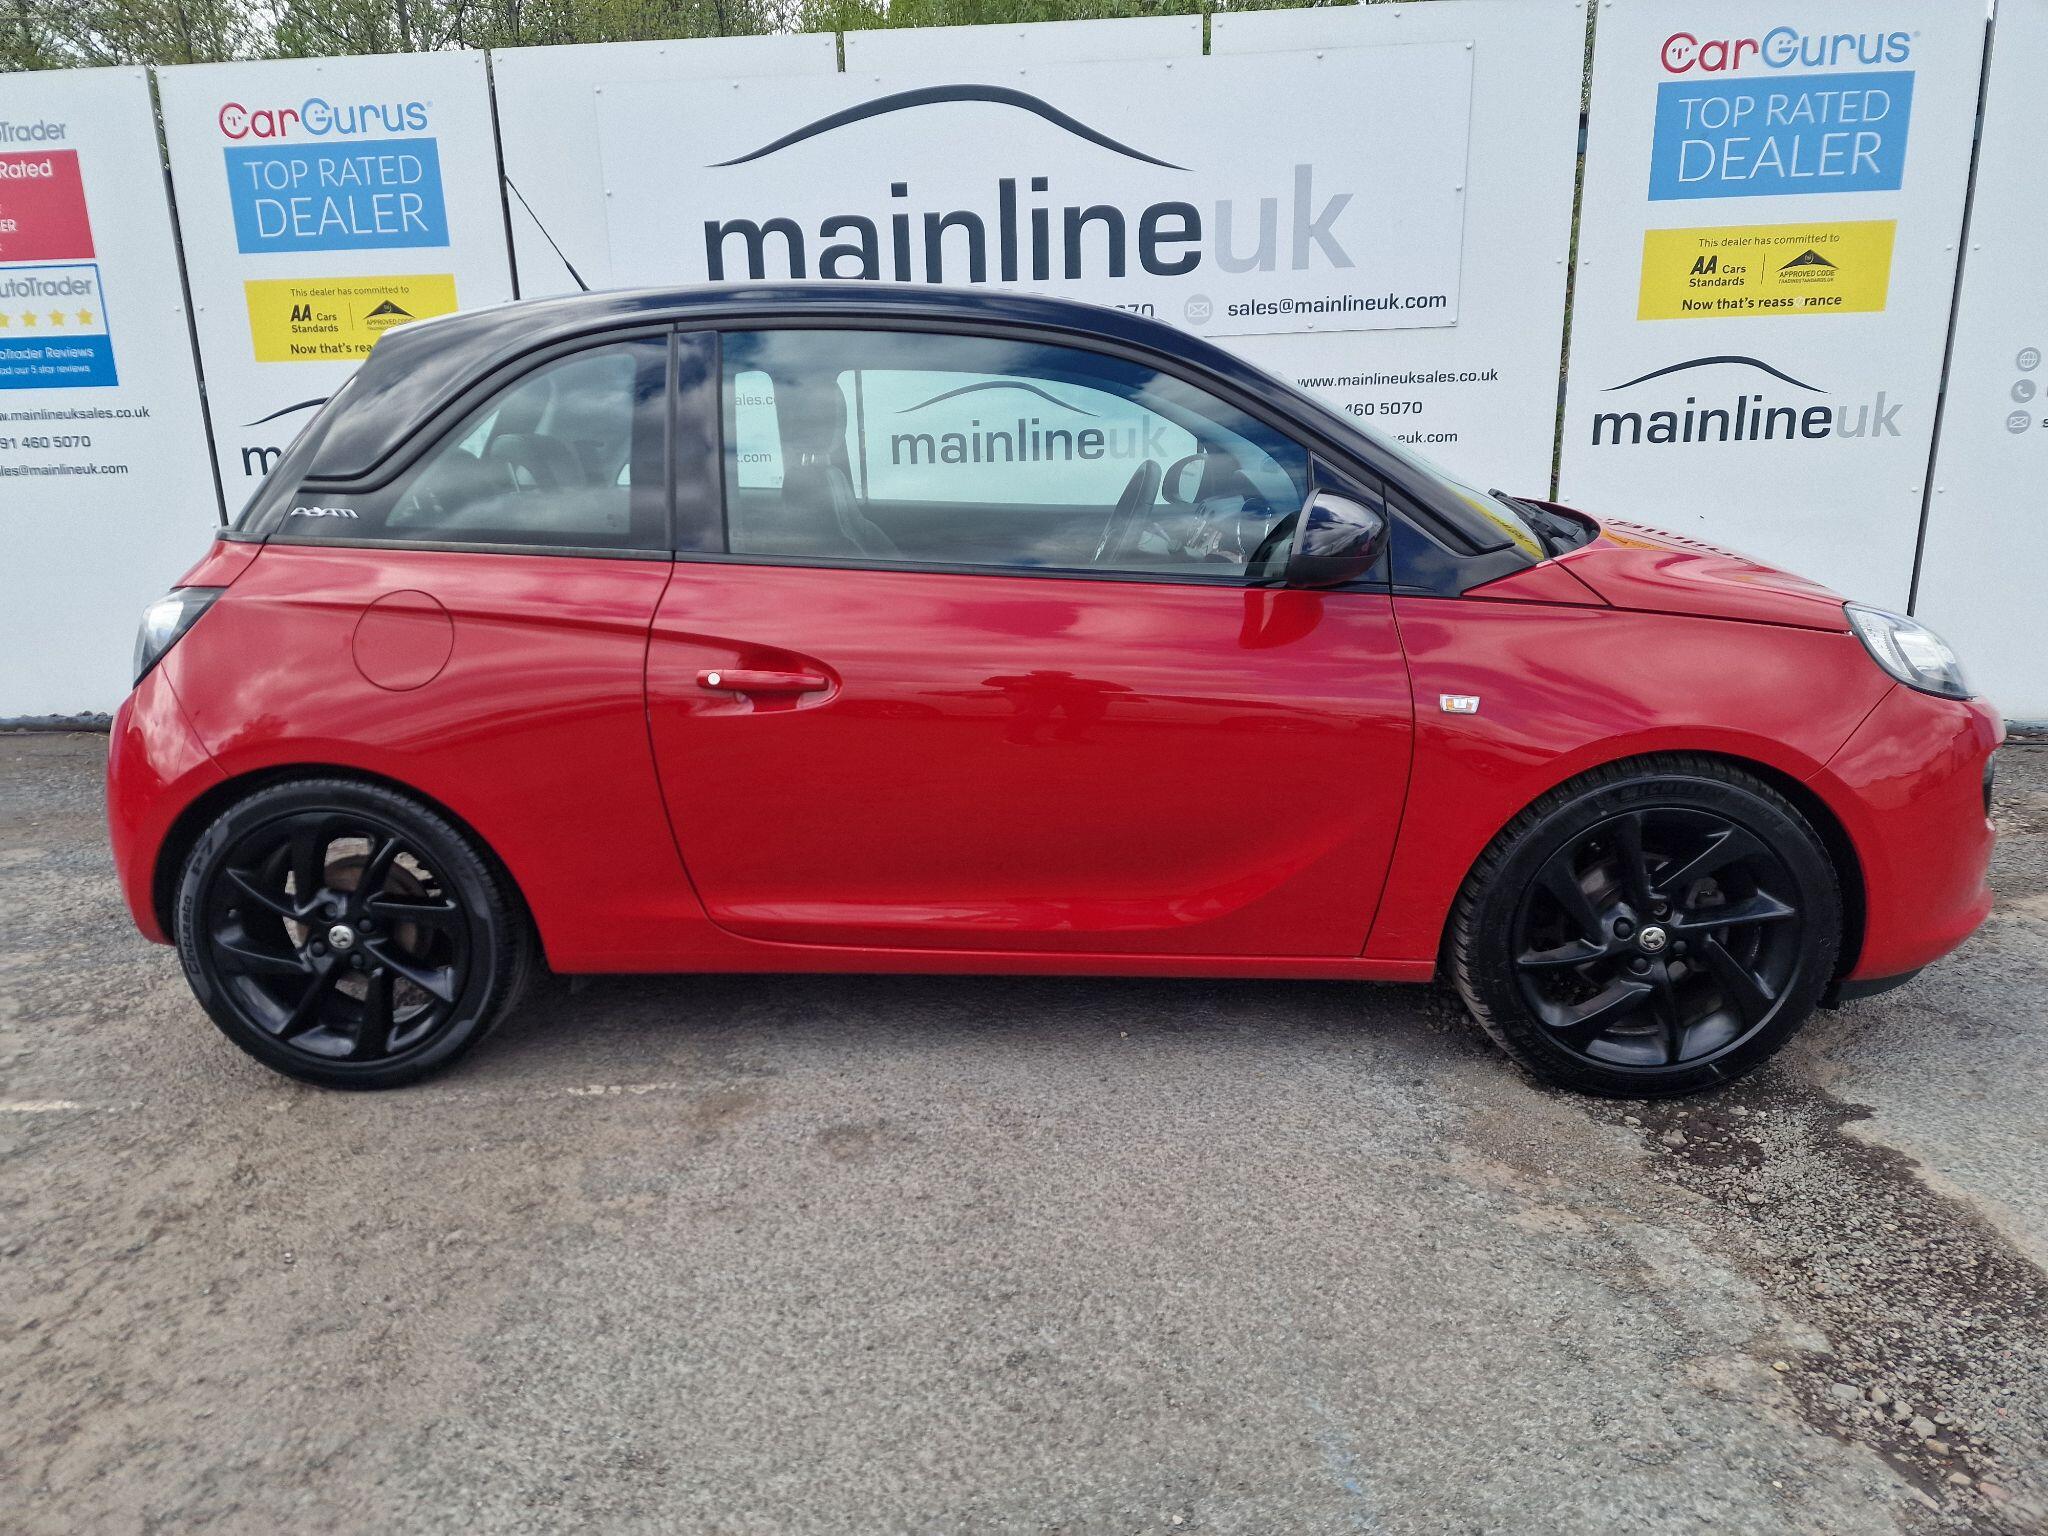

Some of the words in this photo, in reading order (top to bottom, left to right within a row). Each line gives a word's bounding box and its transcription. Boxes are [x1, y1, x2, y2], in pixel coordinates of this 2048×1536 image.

[1661, 26, 1911, 74] CarGurus
[218, 97, 429, 139] CarGurus
[1678, 96, 1755, 130] TOP
[1765, 89, 1891, 127] RATED
[1678, 131, 1882, 183] DEALER
[0, 159, 54, 178] Rated
[243, 160, 308, 191] TOP
[318, 154, 423, 188] RATED
[255, 193, 429, 238] DEALER
[704, 163, 1356, 282] mainlineuk
[1698, 238, 1719, 248] This
[1721, 237, 1752, 247] dealer
[1754, 236, 1771, 246] has
[1773, 234, 1826, 245] committed
[1828, 234, 1840, 243] to
[1690, 255, 1718, 275] AA
[1722, 264, 1746, 274] Cars
[1779, 270, 1816, 278] APPROVED
[1816, 269, 1835, 277] CODE
[290, 288, 308, 297] This
[309, 287, 336, 296] dealer
[337, 287, 352, 296] has
[353, 285, 399, 295] committed
[400, 285, 410, 294] to
[1688, 278, 1745, 288] Standards
[290, 303, 312, 322] AA
[316, 312, 338, 321] Cars
[1227, 293, 1447, 317] sales@mainlineuk.com
[1682, 298, 1713, 311] Now
[1716, 296, 1755, 310] that's
[1758, 295, 1842, 308] reassrance
[291, 324, 339, 333] Standards
[45, 346, 95, 358] Reviews
[290, 343, 317, 355] Now
[320, 342, 352, 354] that's
[14, 367, 29, 375] our
[30, 365, 37, 374] 5
[38, 364, 54, 375] star
[56, 363, 91, 374] reviews
[1298, 368, 1498, 388] www.mainlineuksales.co.uk
[1379, 401, 1423, 415] 5070
[1592, 391, 1903, 446] mainlineuk
[21, 436, 50, 449] 460
[53, 435, 92, 448] 5070
[891, 414, 1168, 465] mainlineuk
[1392, 431, 1458, 444] euk.com
